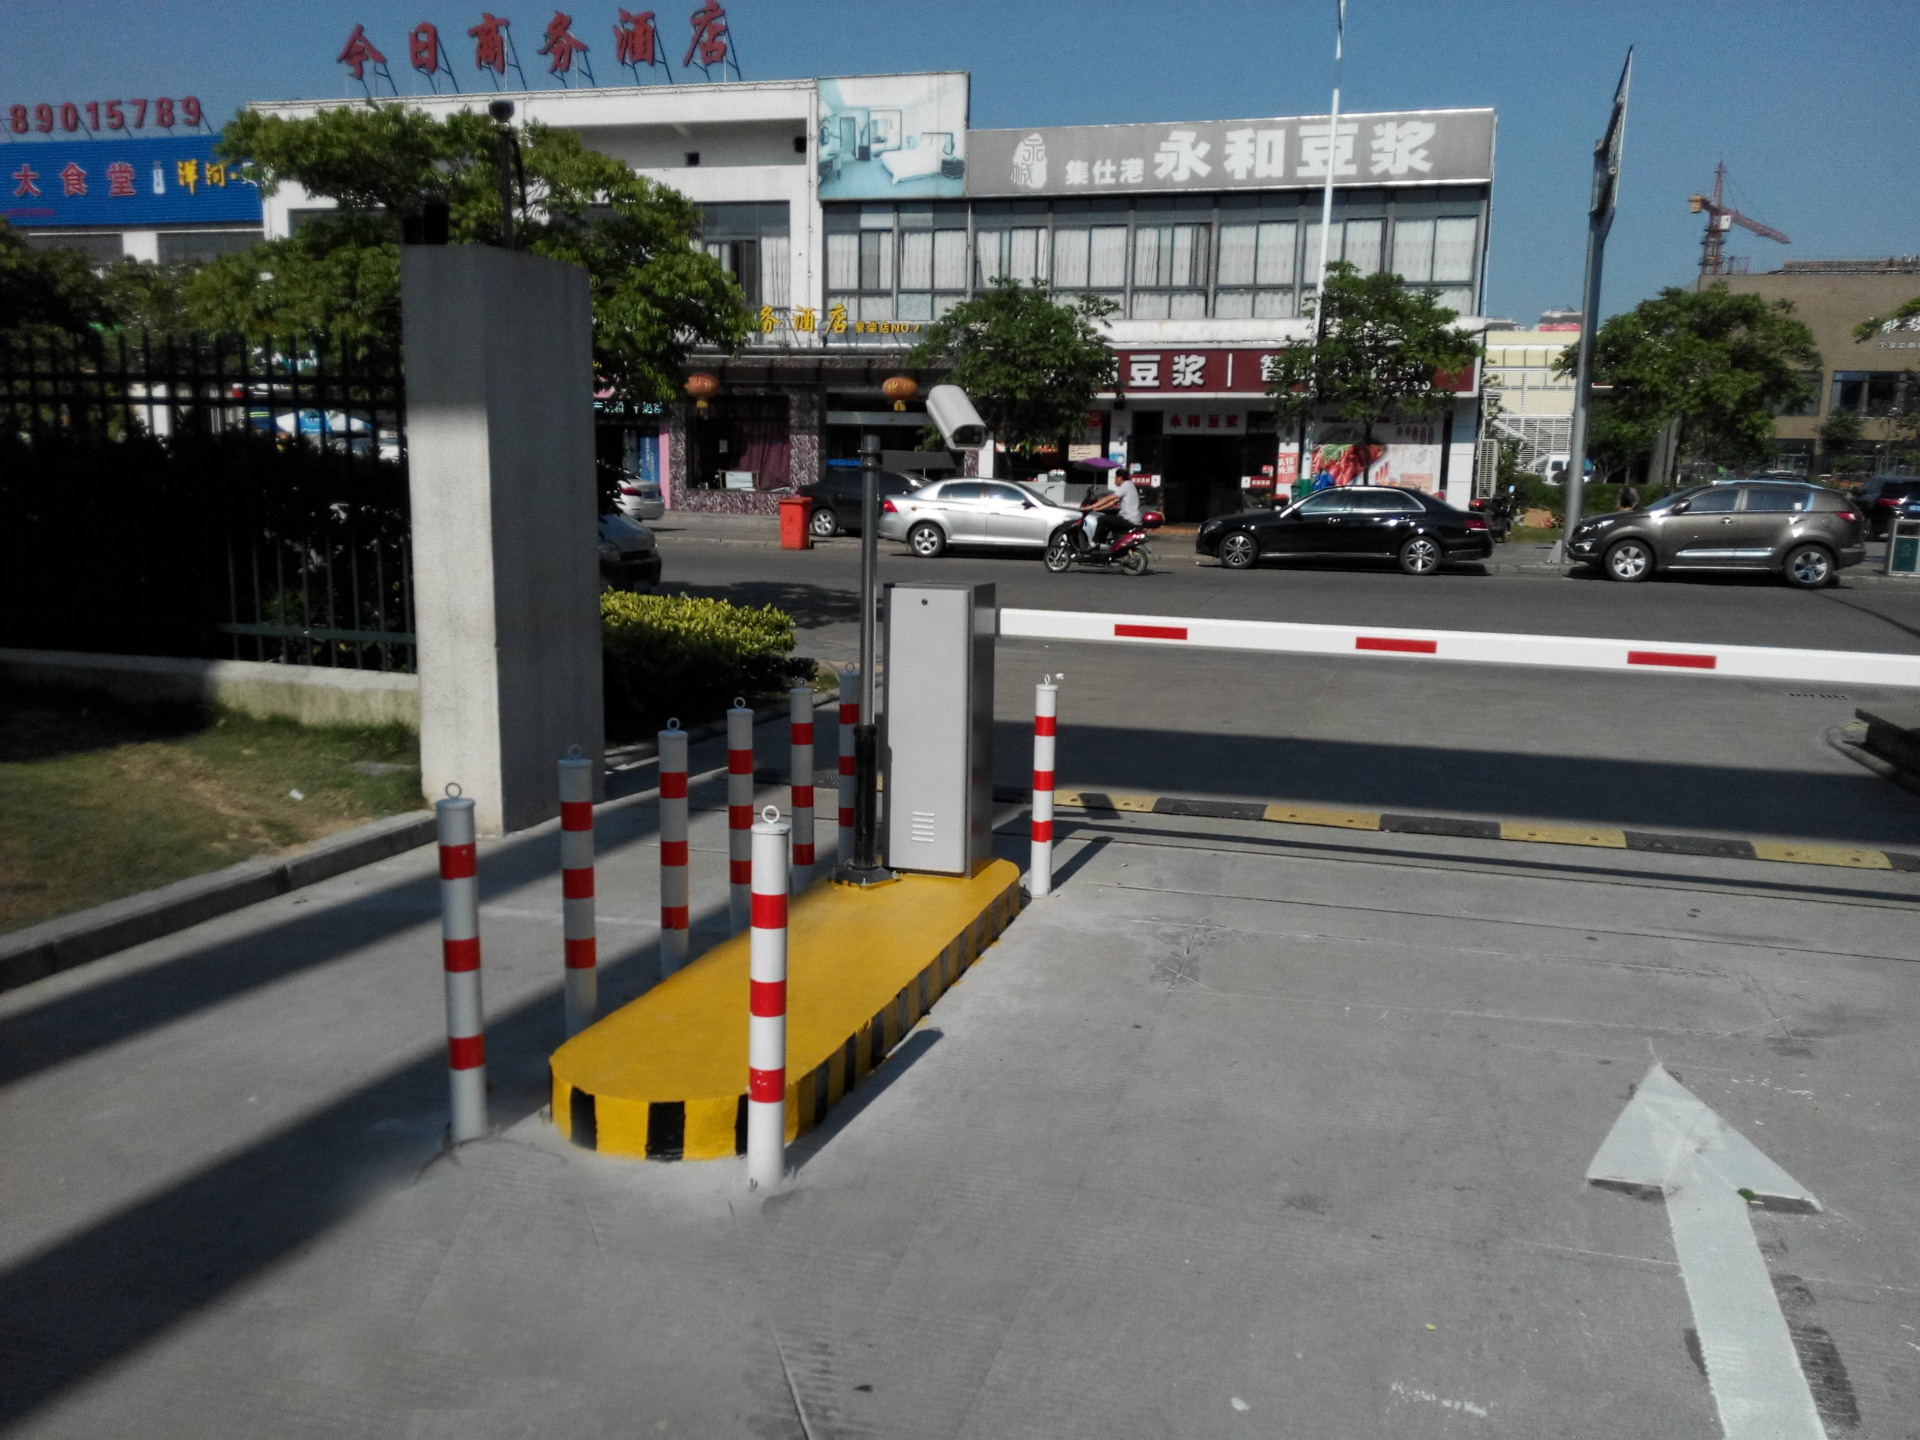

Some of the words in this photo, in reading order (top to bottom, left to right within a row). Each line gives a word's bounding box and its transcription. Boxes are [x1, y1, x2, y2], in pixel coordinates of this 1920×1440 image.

[337, 0, 728, 80] 今日商务酒店
[9, 95, 202, 134] 89015789
[1064, 156, 1145, 186] 集仕港
[1153, 120, 1437, 183] 永和豆浆
[12, 161, 136, 197] 大食堂
[1169, 413, 1240, 428] 永和豆浆
